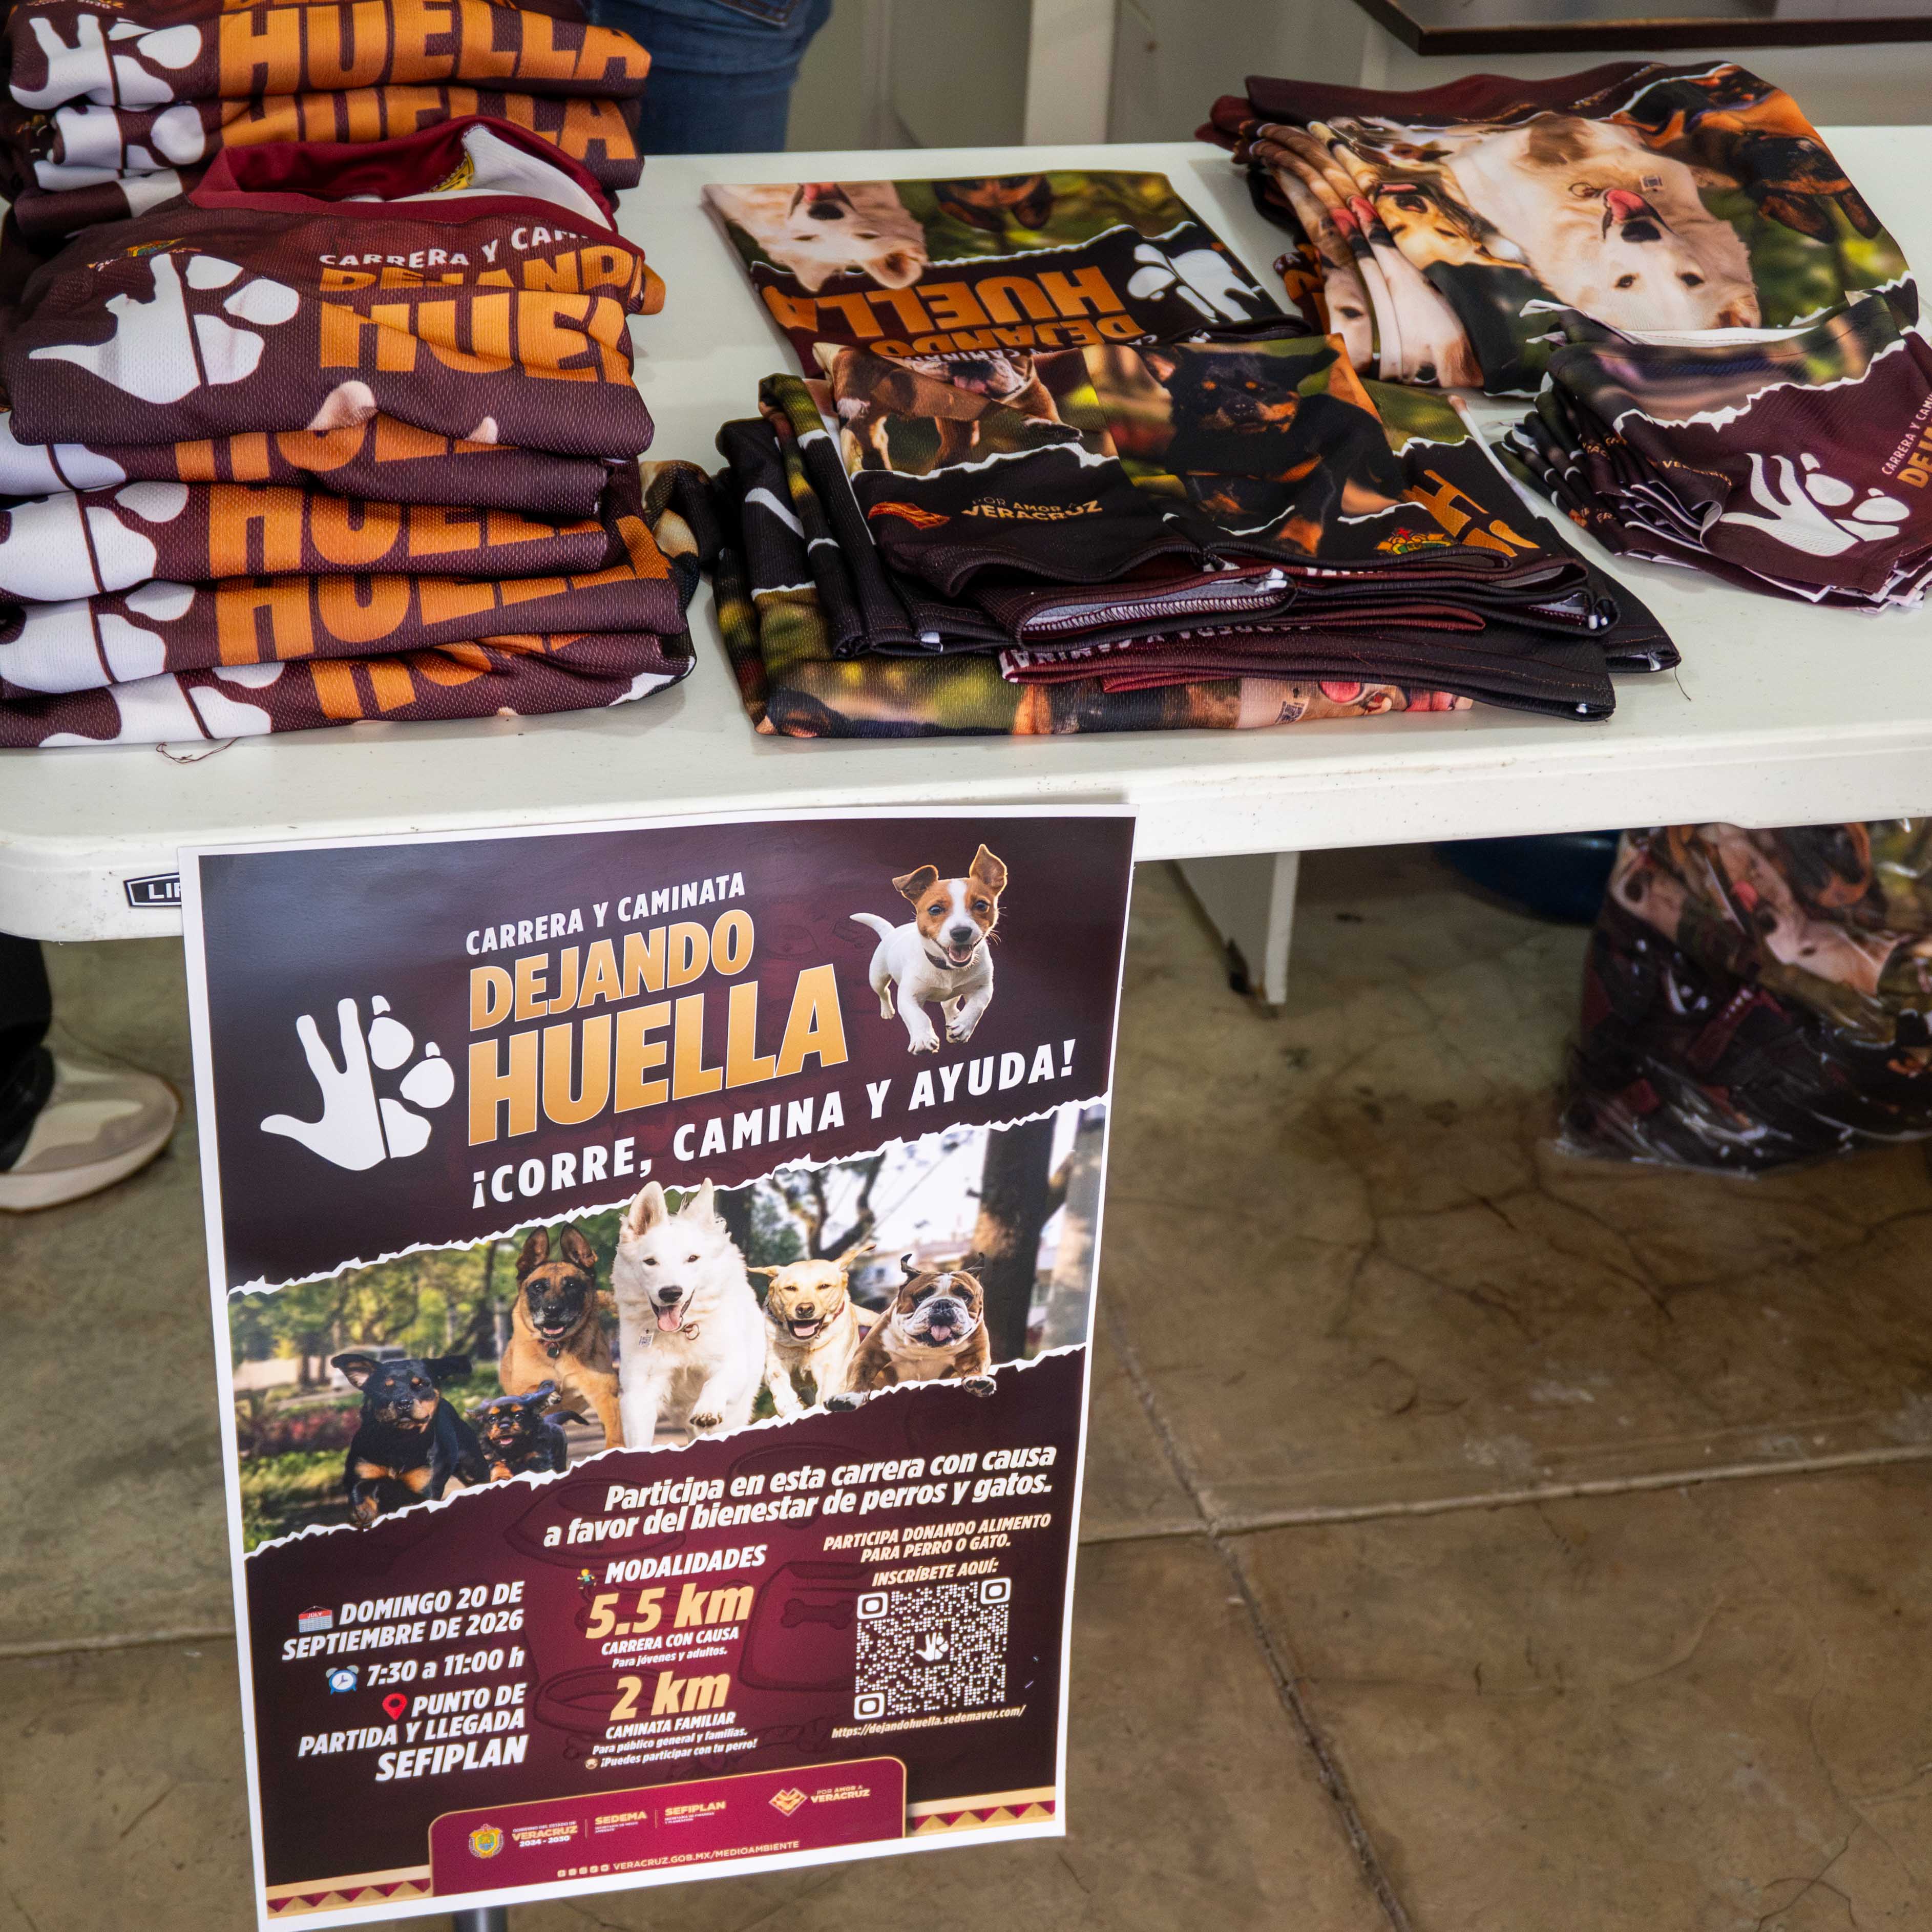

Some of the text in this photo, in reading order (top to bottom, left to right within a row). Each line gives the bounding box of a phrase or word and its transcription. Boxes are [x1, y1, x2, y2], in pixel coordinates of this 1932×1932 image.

[219, 0, 652, 96] HUELLA
[320, 248, 469, 268] CARRERA
[481, 239, 499, 263] Y
[762, 265, 1125, 339] HUELLA
[869, 315, 1146, 356] DEJANDO
[1882, 433, 1916, 475] CARRERA
[961, 499, 1103, 520] VERACRUZ
[466, 872, 745, 955] CARRERA Y CAMINATA
[470, 909, 754, 1032] DEJANDO
[469, 963, 849, 1146] HUELLA
[472, 1039, 1076, 1209] ¡CORRE, CAMINA Y AYUDA!
[604, 1446, 1057, 1511] Participa en esta carrera con causa
[543, 1472, 1052, 1547] a favor del bienestar de perros y gatos.
[823, 1513, 1052, 1551] PARTICIPA DONANDO ALIMENTO
[860, 1534, 1011, 1563] PARA PERRO O GATO.
[604, 1544, 768, 1584] MODALIDADES
[872, 1557, 1000, 1587] INSCRÍBETE AQUÍ:
[339, 1581, 526, 1626] DOMINGO 20 DE
[585, 1582, 754, 1640] 5.5 km
[282, 1609, 524, 1661] SEPTIEMBRE DE 2026
[601, 1626, 739, 1656] CARRERA CON CAUSA
[366, 1646, 526, 1687] 7:30 a 11:00 h
[612, 1646, 728, 1668] Para jóvenes y adultos.
[411, 1682, 528, 1717] PUNTO DE
[609, 1671, 730, 1721] 2 km
[297, 1708, 525, 1757] PARTIDA Y LLEGADA
[605, 1711, 737, 1740] CAMINATA FAMILIAR
[831, 1704, 1026, 1738] https://dejandohuella.sedemaver.com/
[374, 1734, 530, 1781] SEFIPLAN
[592, 1728, 748, 1755] Para público general y familias.
[600, 1738, 758, 1768] ¡Puedes participar con tu perro!
[665, 1801, 726, 1816] SEFIPLAN
[810, 1789, 870, 1803] VERACRUZ
[512, 1825, 578, 1841] VERACRUZ
[595, 1811, 647, 1825] SEDEMA
[519, 1839, 542, 1847] 2024
[613, 1841, 800, 1870] VERACRUZ.GOB.MX/MEDIOAMBIENTE
